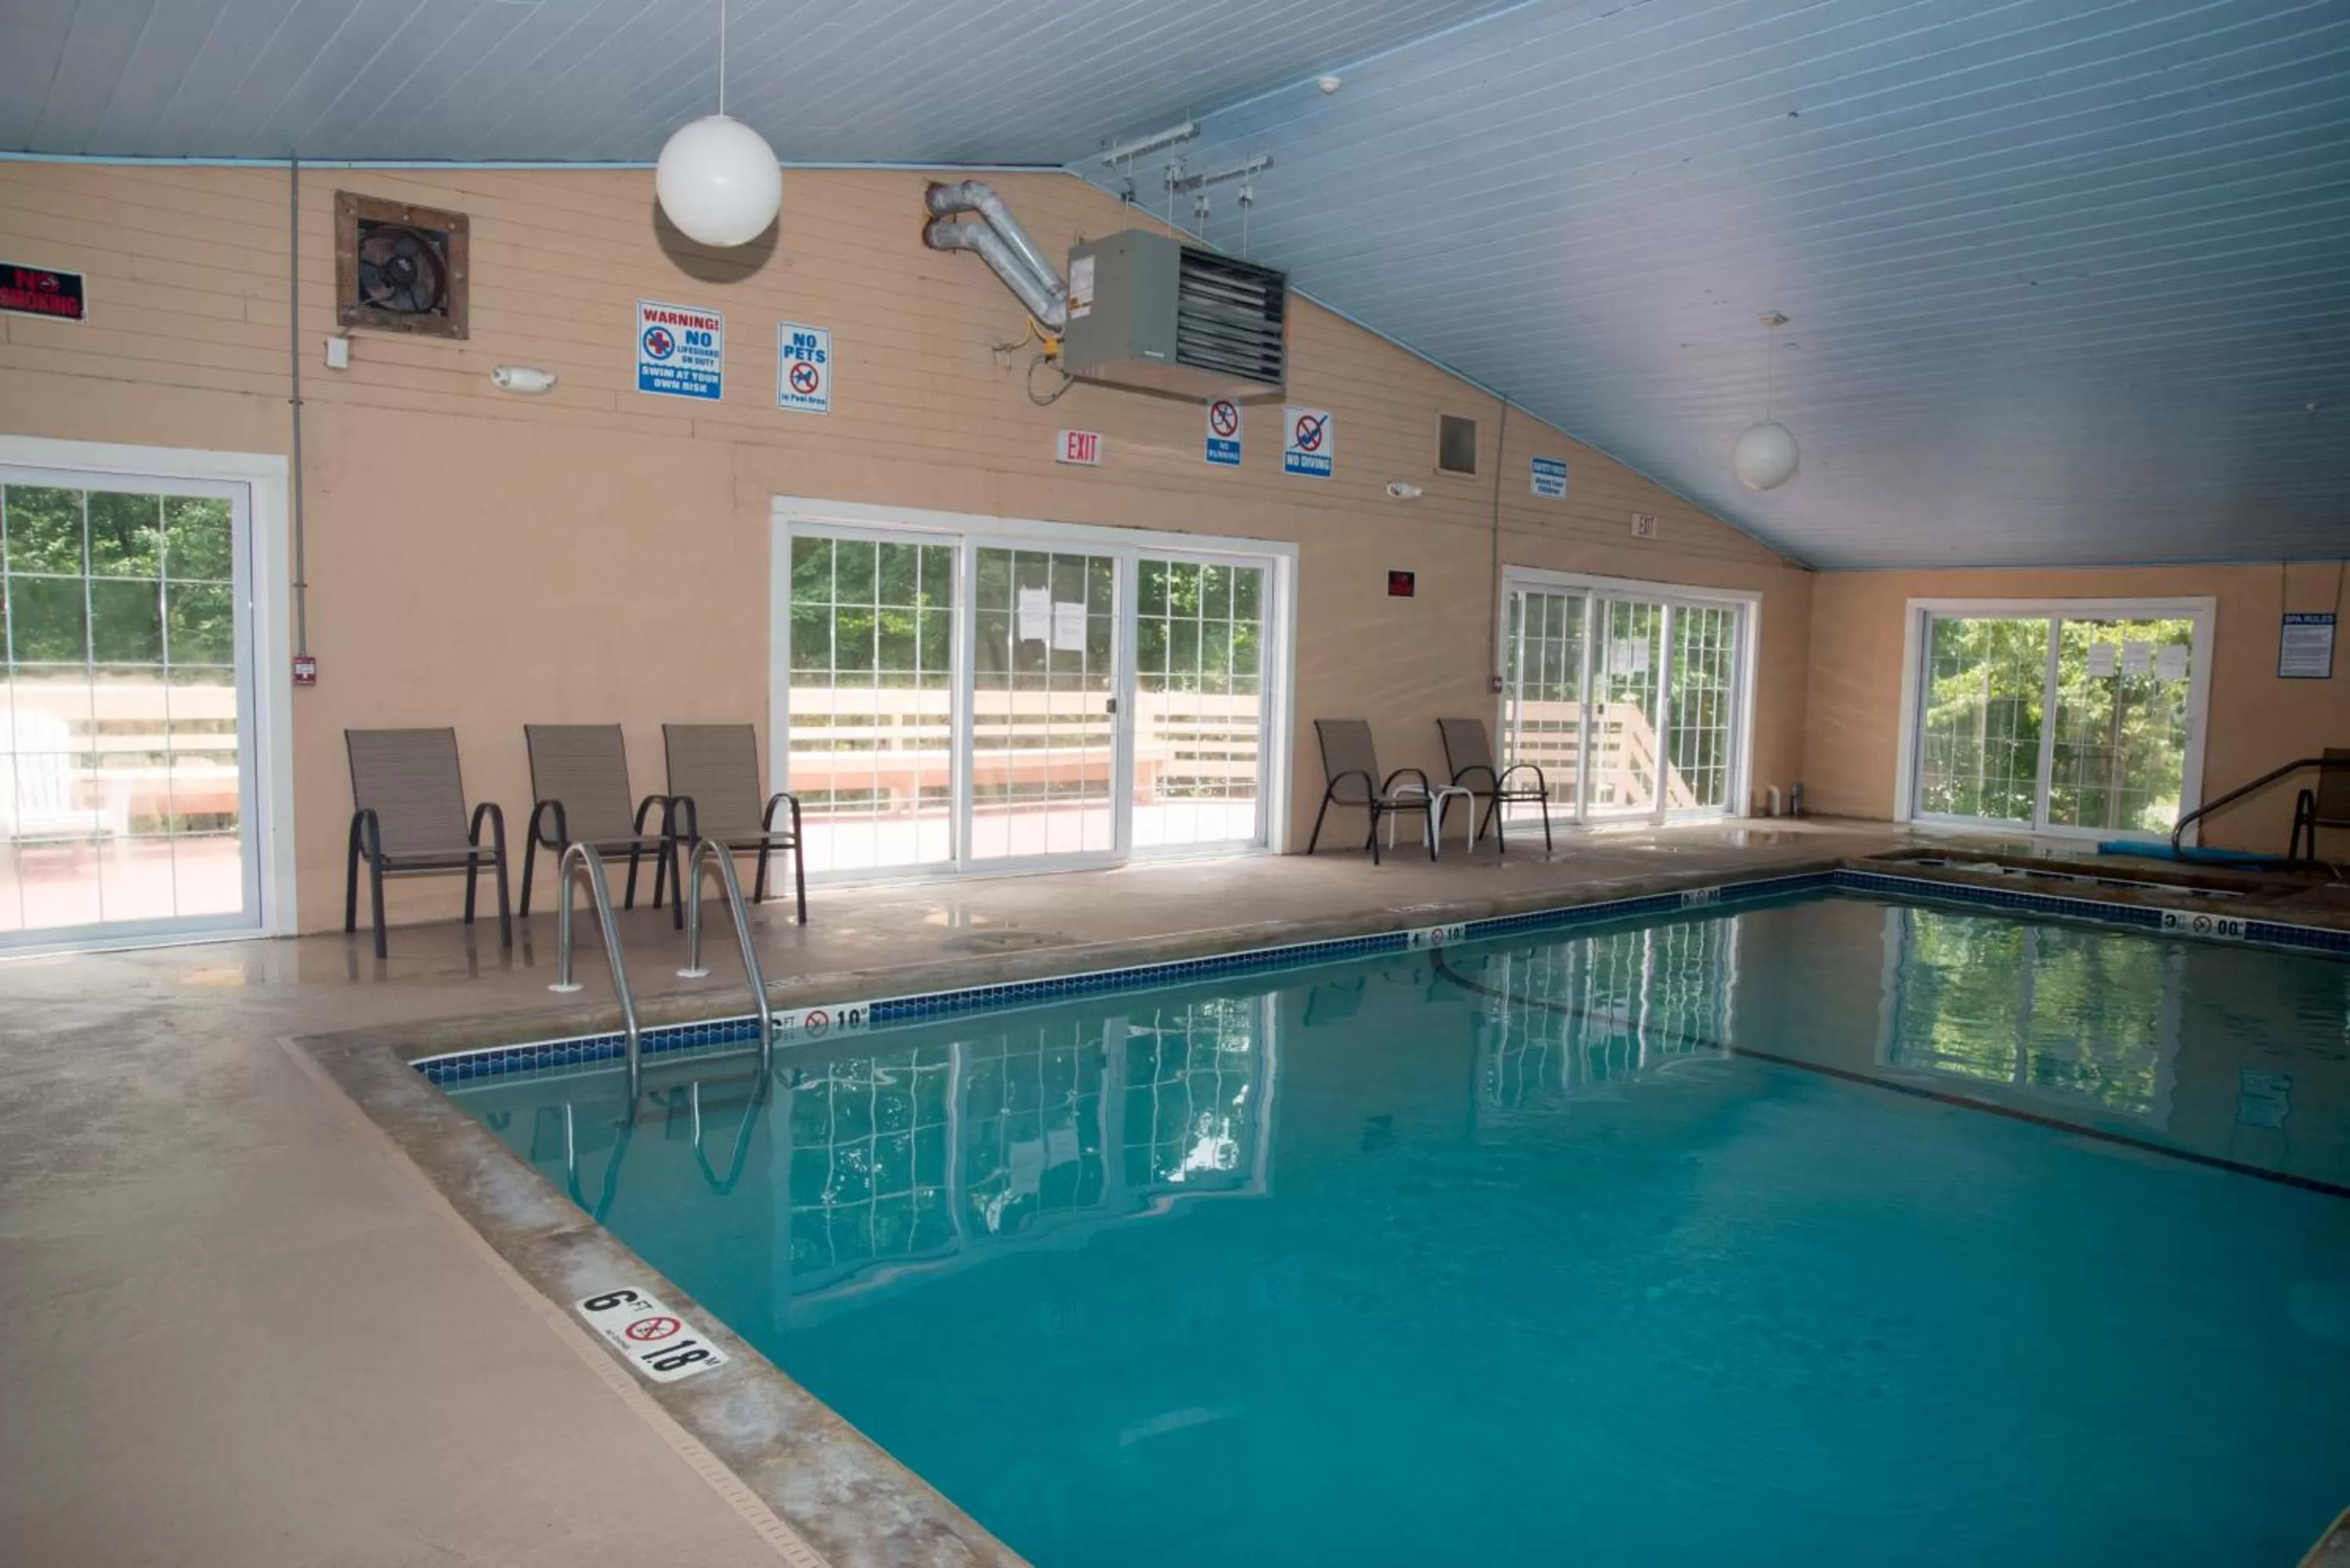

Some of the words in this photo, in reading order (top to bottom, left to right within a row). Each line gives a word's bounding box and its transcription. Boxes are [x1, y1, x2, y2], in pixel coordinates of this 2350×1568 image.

[0, 287, 78, 316] SMOKING
[643, 308, 719, 332] WARNING!
[685, 330, 712, 347] NO
[793, 333, 816, 349] NO
[677, 345, 719, 358] LIFEGUARD
[784, 345, 826, 363] PETS
[682, 355, 694, 363] ON
[695, 357, 714, 367] DUTY
[642, 365, 674, 378] SWIM
[676, 369, 690, 379] AT
[692, 371, 718, 383] YOUR
[654, 378, 681, 389] OWN
[682, 381, 707, 392] RISK
[1068, 432, 1097, 461] EXIT
[1287, 453, 1300, 466] NO
[1301, 456, 1329, 471] DIVING
[584, 1290, 639, 1311] 6
[627, 1299, 653, 1312] FT
[641, 1339, 710, 1372] 1.8
